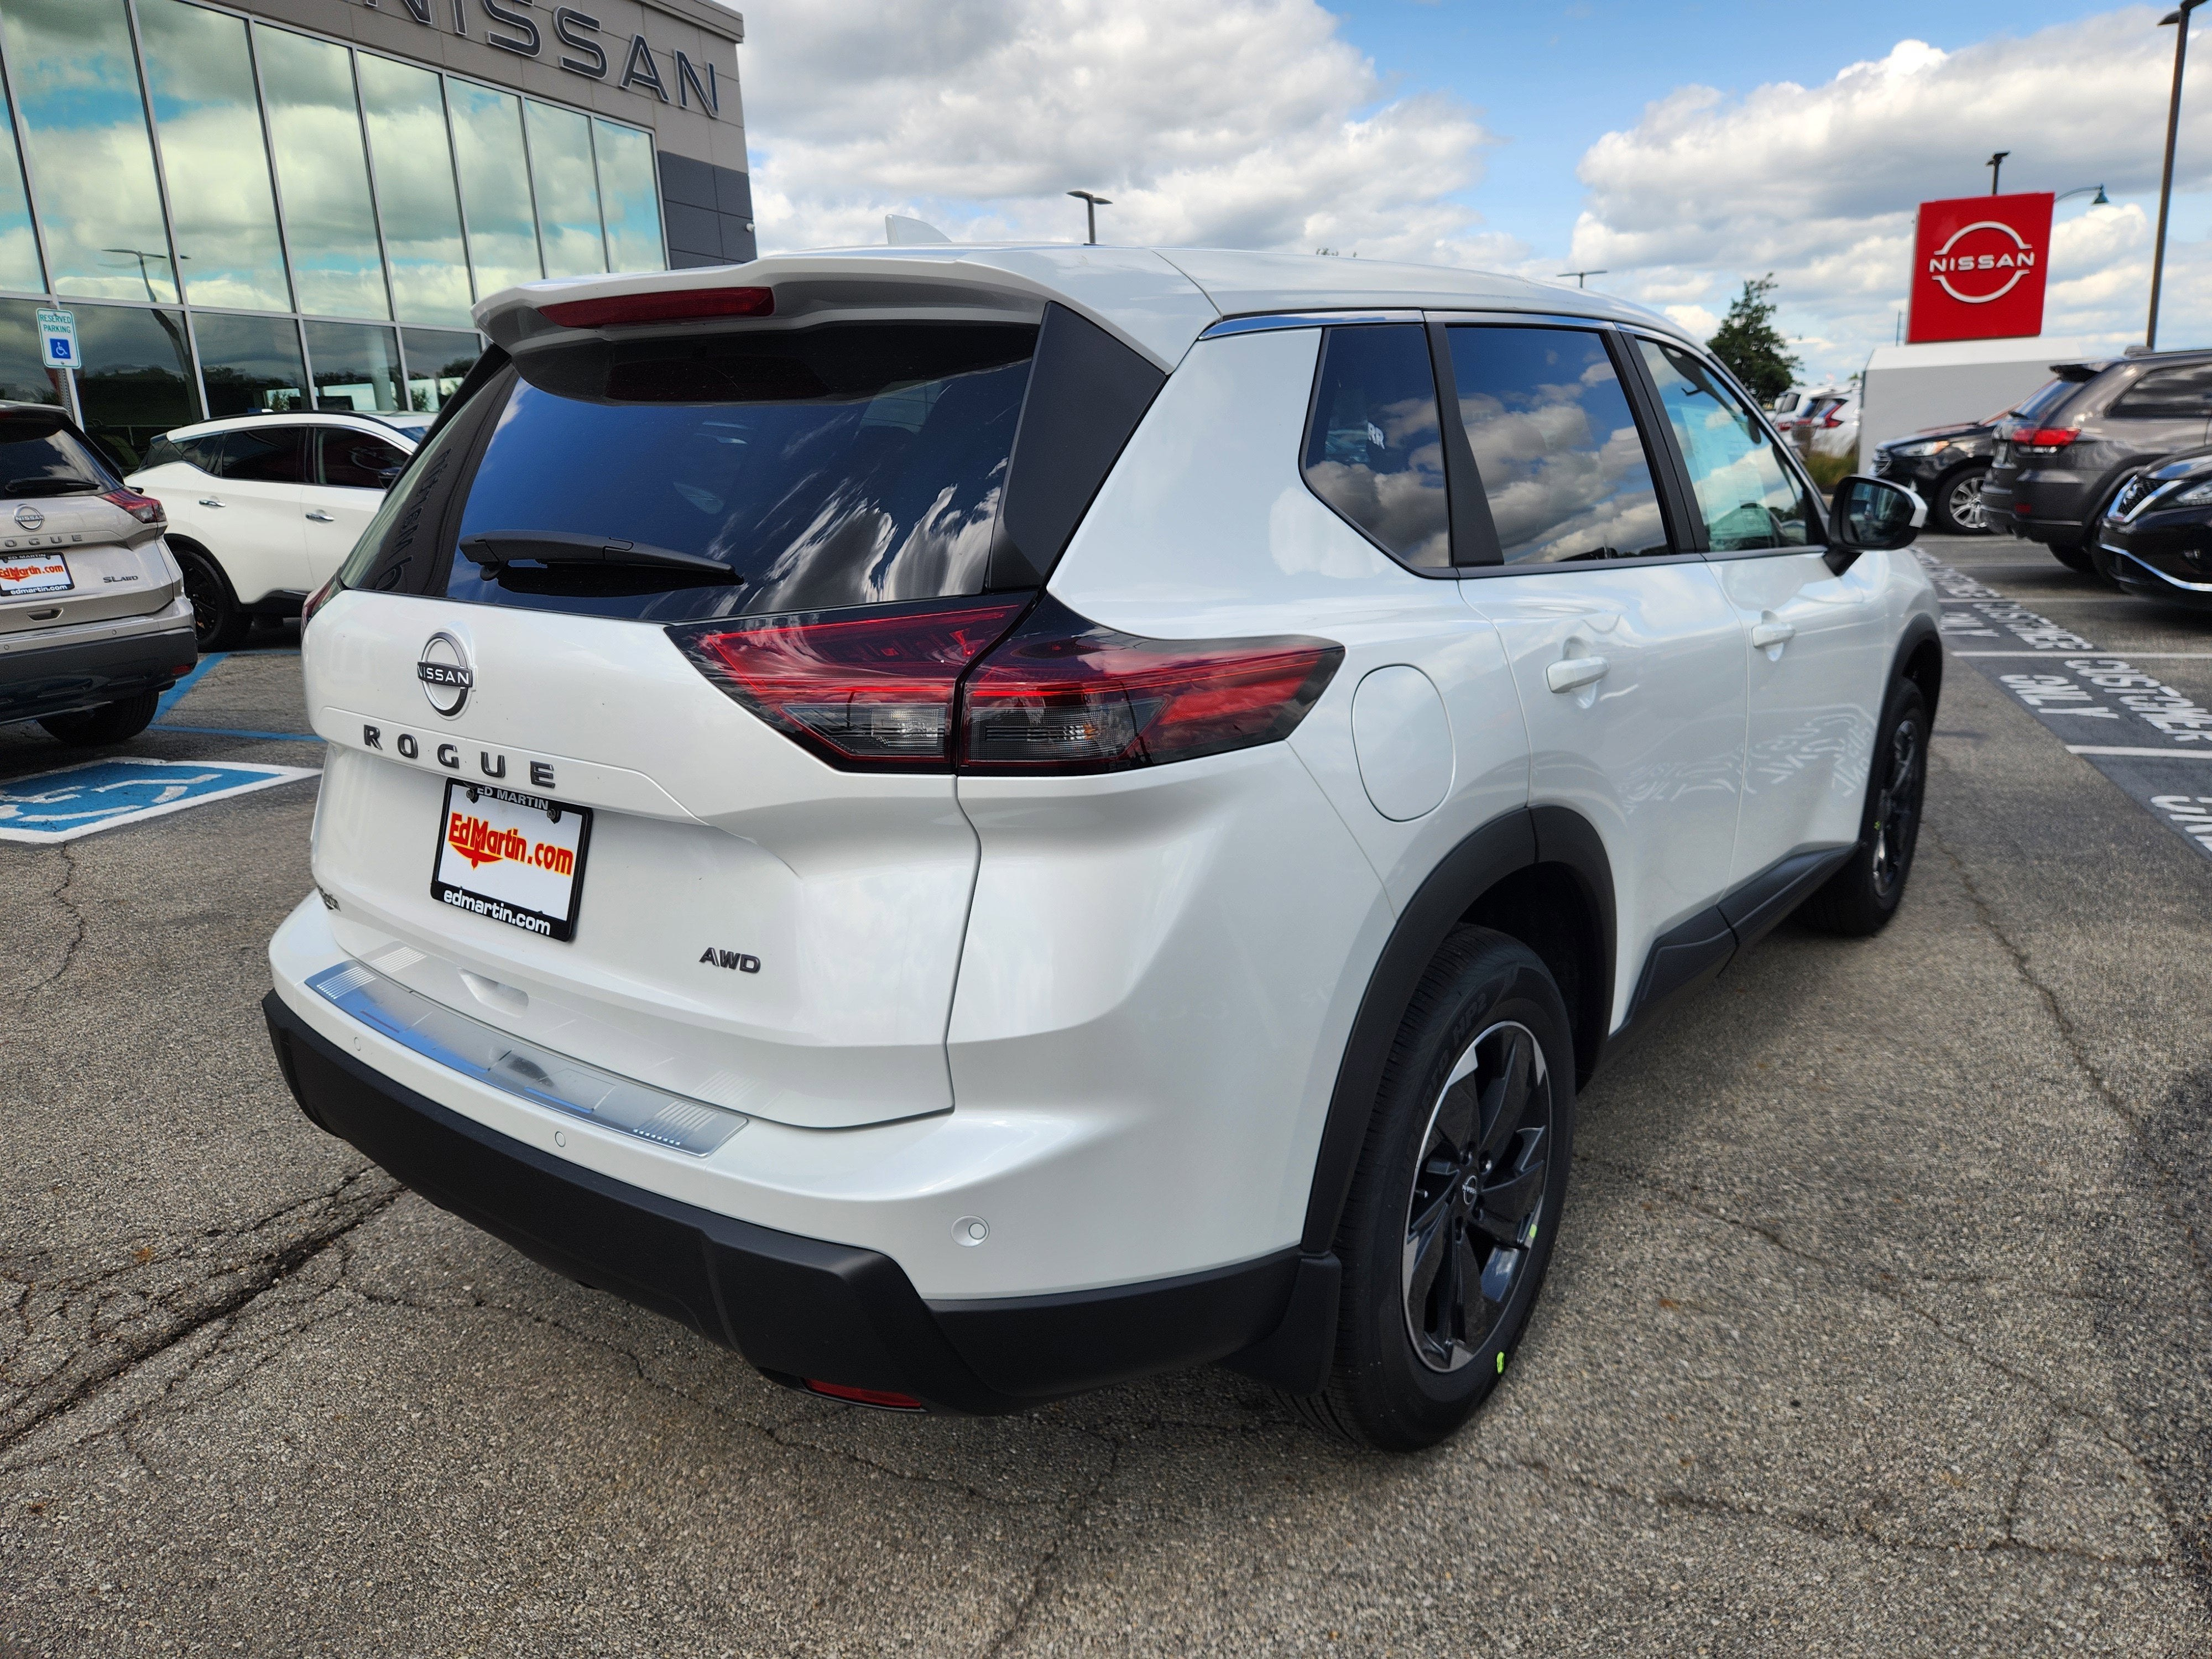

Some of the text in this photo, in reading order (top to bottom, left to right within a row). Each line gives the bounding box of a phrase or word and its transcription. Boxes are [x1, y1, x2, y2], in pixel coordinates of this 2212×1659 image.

[1929, 252, 2035, 273] NISSAN
[39, 314, 71, 324] RESERVED
[44, 324, 71, 333] PARKING
[4, 534, 82, 547] OGUE
[11, 585, 67, 595] edmartin.com
[418, 665, 470, 685] NISSAN
[1999, 674, 2120, 719] ONLY
[363, 724, 556, 789] ROGUE
[476, 786, 549, 811] ED MARTIN
[448, 812, 574, 876] EdMartin.com
[444, 889, 551, 936] edmartin.com
[699, 947, 761, 974] AWD
